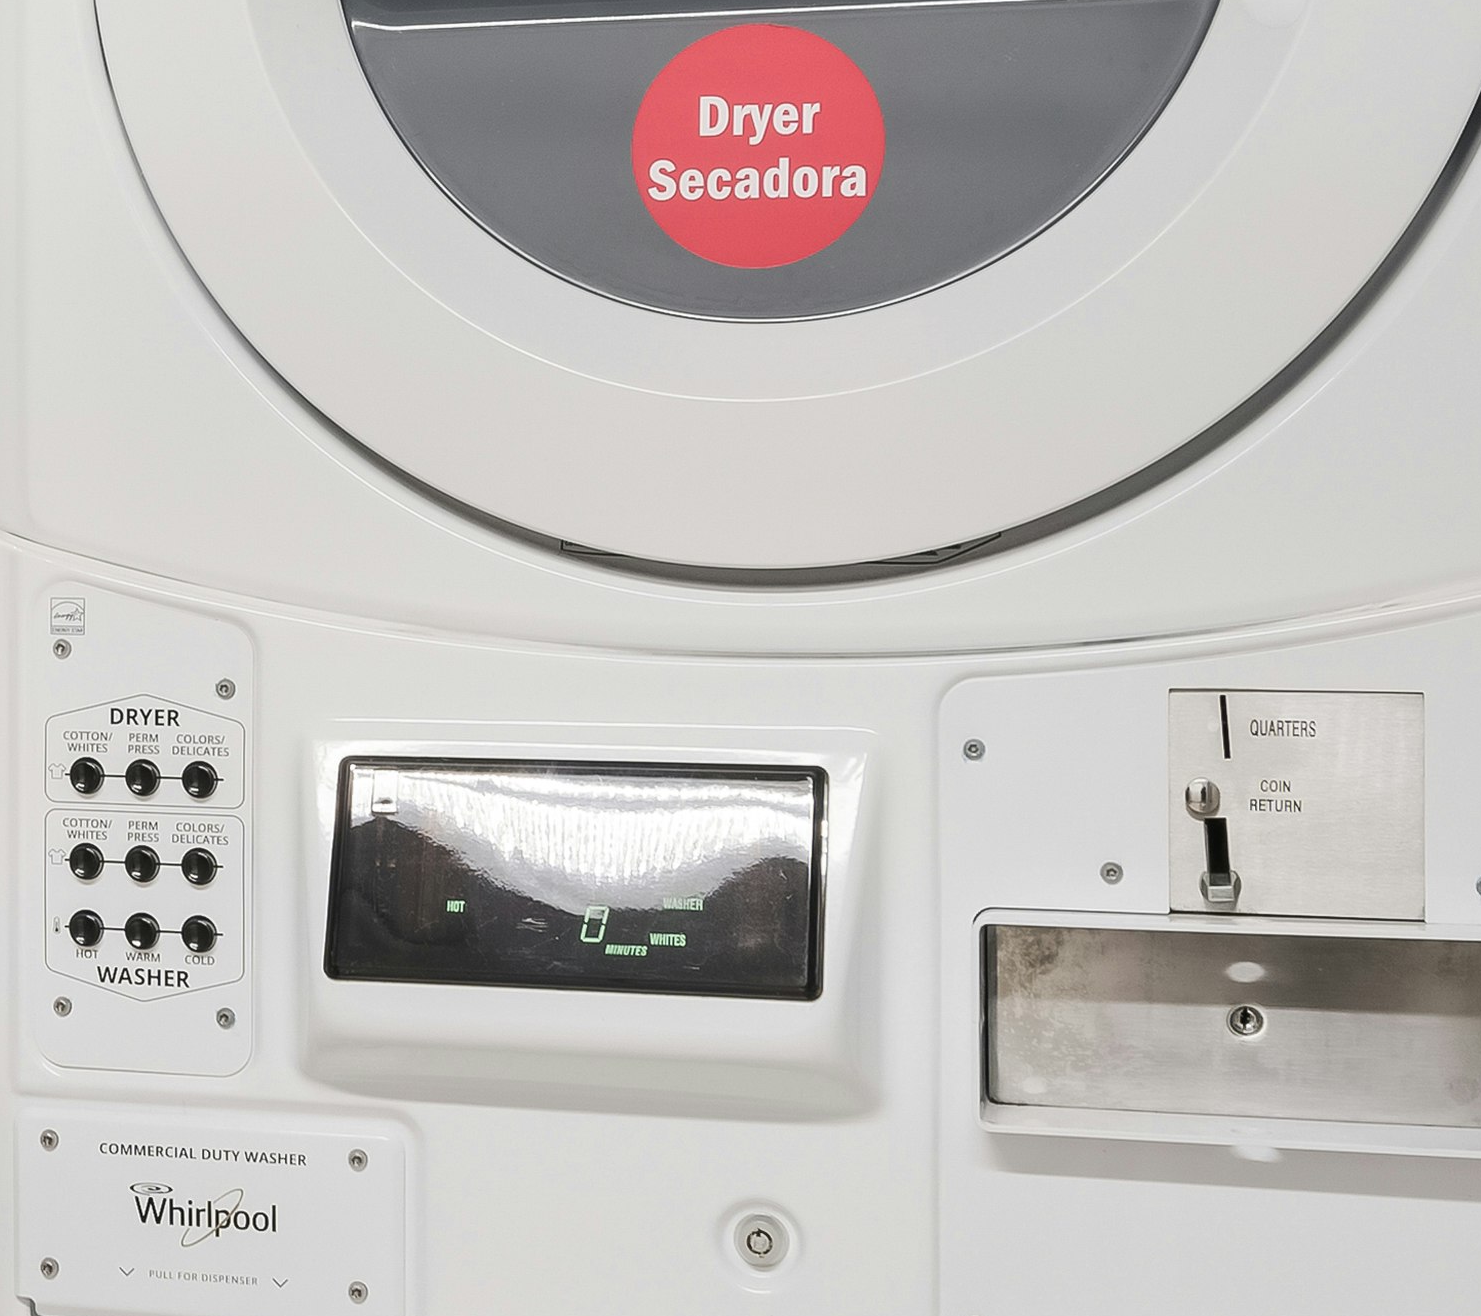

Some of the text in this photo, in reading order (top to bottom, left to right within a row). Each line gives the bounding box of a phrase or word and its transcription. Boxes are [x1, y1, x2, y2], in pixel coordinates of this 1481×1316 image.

[699, 96, 821, 146] Dryer
[648, 157, 867, 201] Secadora
[110, 708, 180, 727] DRYER
[1250, 719, 1316, 737] QUARTERS
[63, 731, 112, 741] COTTON/
[129, 733, 159, 743] PERM
[176, 734, 225, 745] COLORS/
[67, 743, 108, 753] WHITES
[128, 745, 160, 755] PRESS
[172, 746, 229, 757] DELICATES
[1260, 779, 1291, 792] COIN
[1249, 798, 1302, 813] RETURN
[62, 818, 112, 829] COTTON/
[128, 821, 158, 831] PERM
[176, 822, 225, 833] COLORS/
[67, 830, 107, 840] WHITES
[127, 833, 159, 843] PRESS
[171, 834, 229, 845] DELICATES
[446, 899, 466, 913] HOT
[663, 897, 704, 911] WASHER
[580, 905, 609, 943] 0
[649, 932, 687, 947] WHITES
[76, 949, 98, 959] HOT
[604, 944, 648, 957] MINUTES
[126, 952, 161, 962] WARM
[185, 955, 215, 966] COLD
[97, 966, 190, 988] WASHER
[99, 1142, 307, 1166] COMMERCIAL DUTY WASHER
[134, 1195, 277, 1237] Whirlpool
[149, 1269, 258, 1286] PULL FOR DISPENSER
